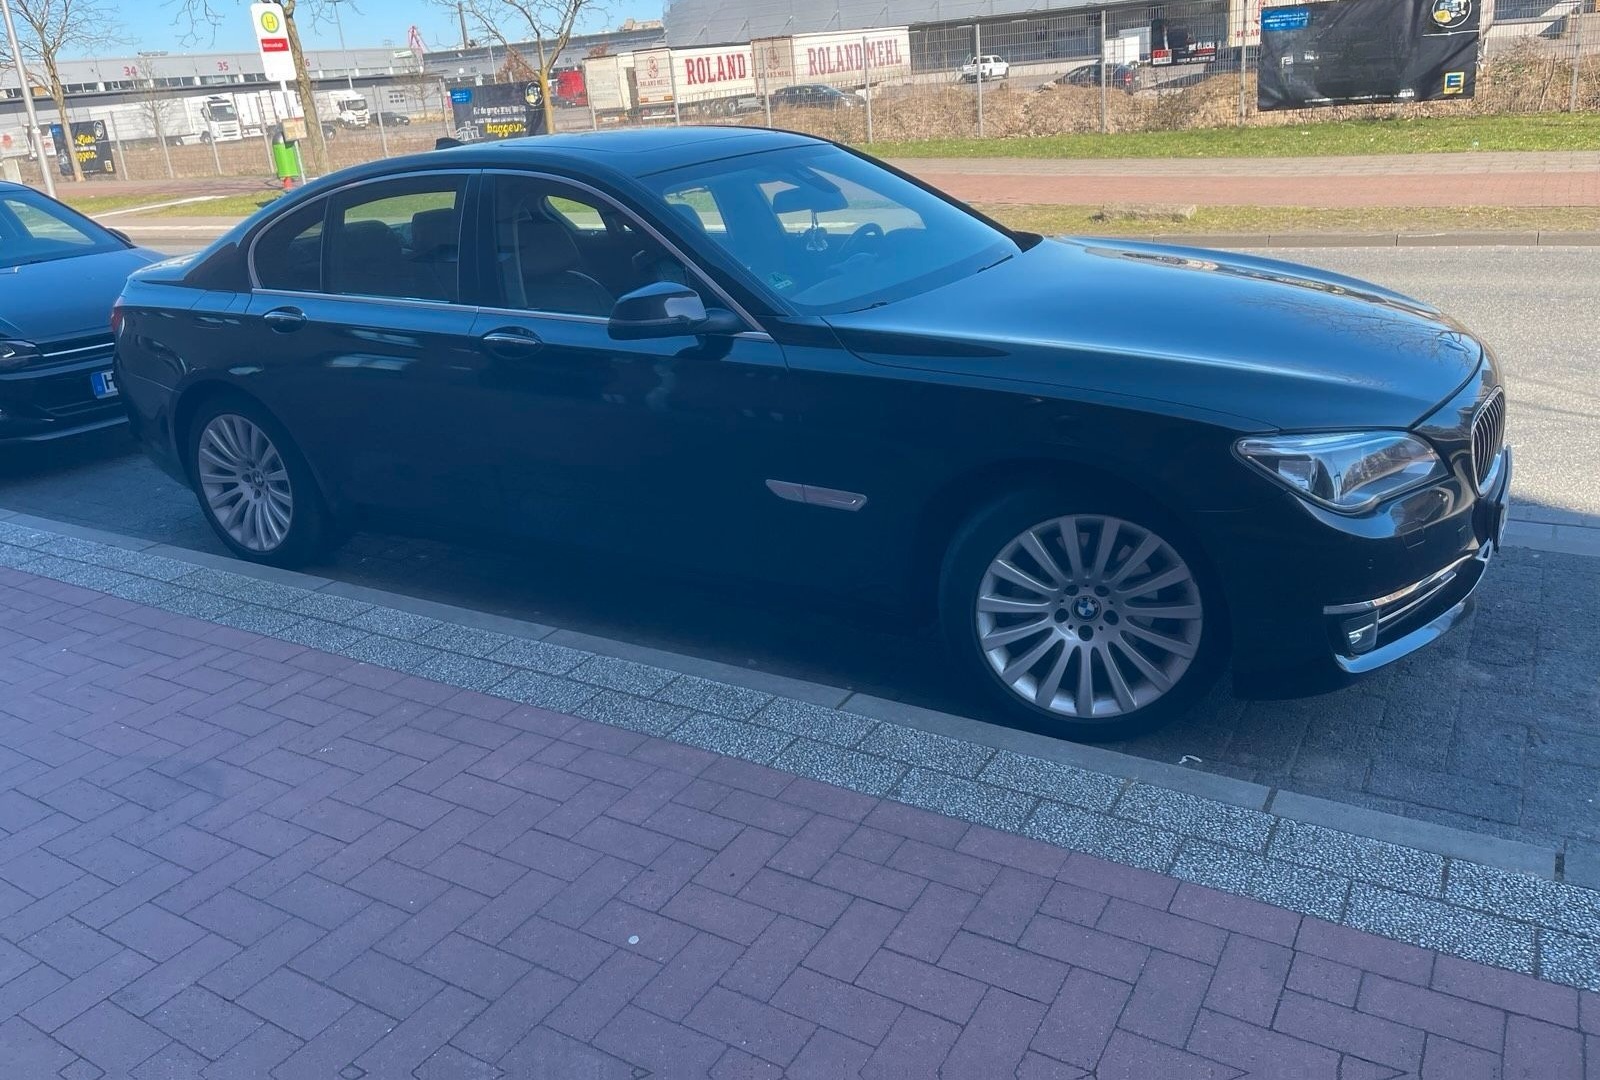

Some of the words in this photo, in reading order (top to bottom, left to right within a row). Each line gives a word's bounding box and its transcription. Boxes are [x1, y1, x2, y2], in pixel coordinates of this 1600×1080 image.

[265, 16, 275, 29] H
[807, 43, 862, 77] ROLAND
[864, 39, 903, 68] MEHL
[123, 66, 137, 78] 34
[217, 61, 229, 72] 35
[684, 53, 746, 86] ROLAND
